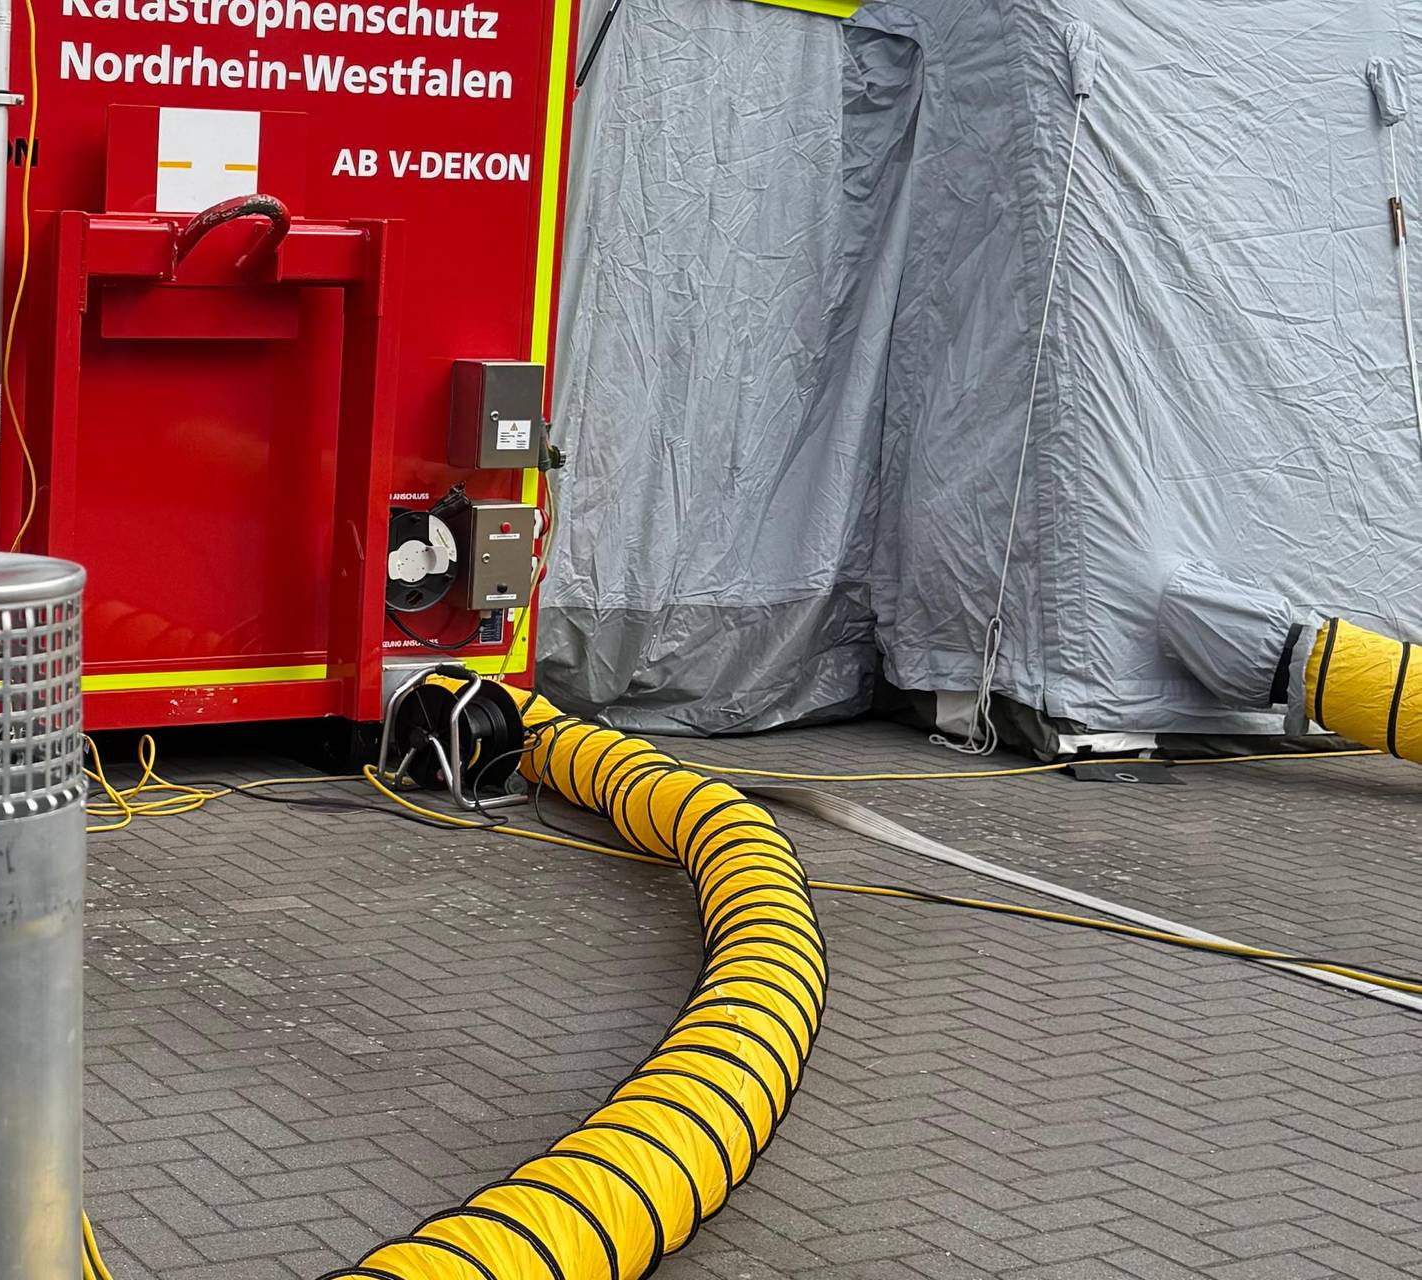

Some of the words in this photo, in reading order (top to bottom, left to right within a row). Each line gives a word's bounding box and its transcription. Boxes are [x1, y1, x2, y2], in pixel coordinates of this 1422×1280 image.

[60, 41, 513, 99] Nordrhein-Westfalen
[331, 148, 378, 177] AB
[389, 150, 531, 181] V-DEKON
